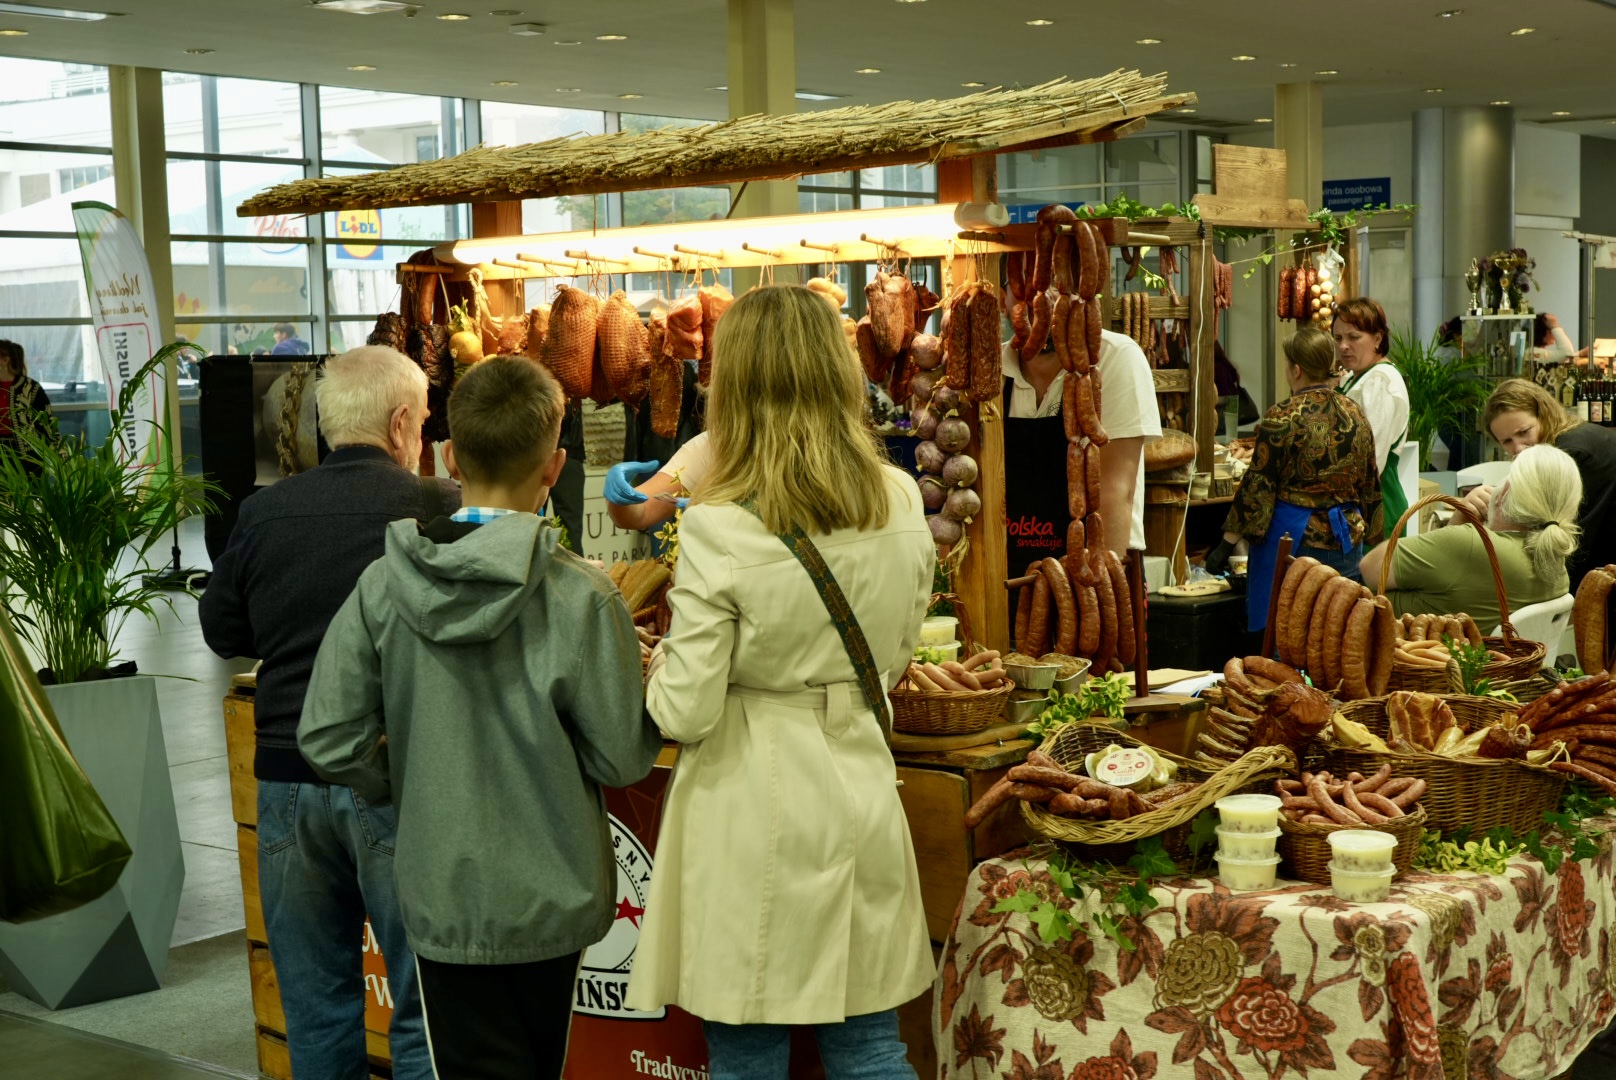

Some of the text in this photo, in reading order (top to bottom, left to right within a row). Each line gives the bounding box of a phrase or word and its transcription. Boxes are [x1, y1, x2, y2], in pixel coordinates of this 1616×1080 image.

[1345, 184, 1382, 194] osobowa
[1328, 196, 1362, 205] passenger
[1016, 536, 1063, 551] smakuje
